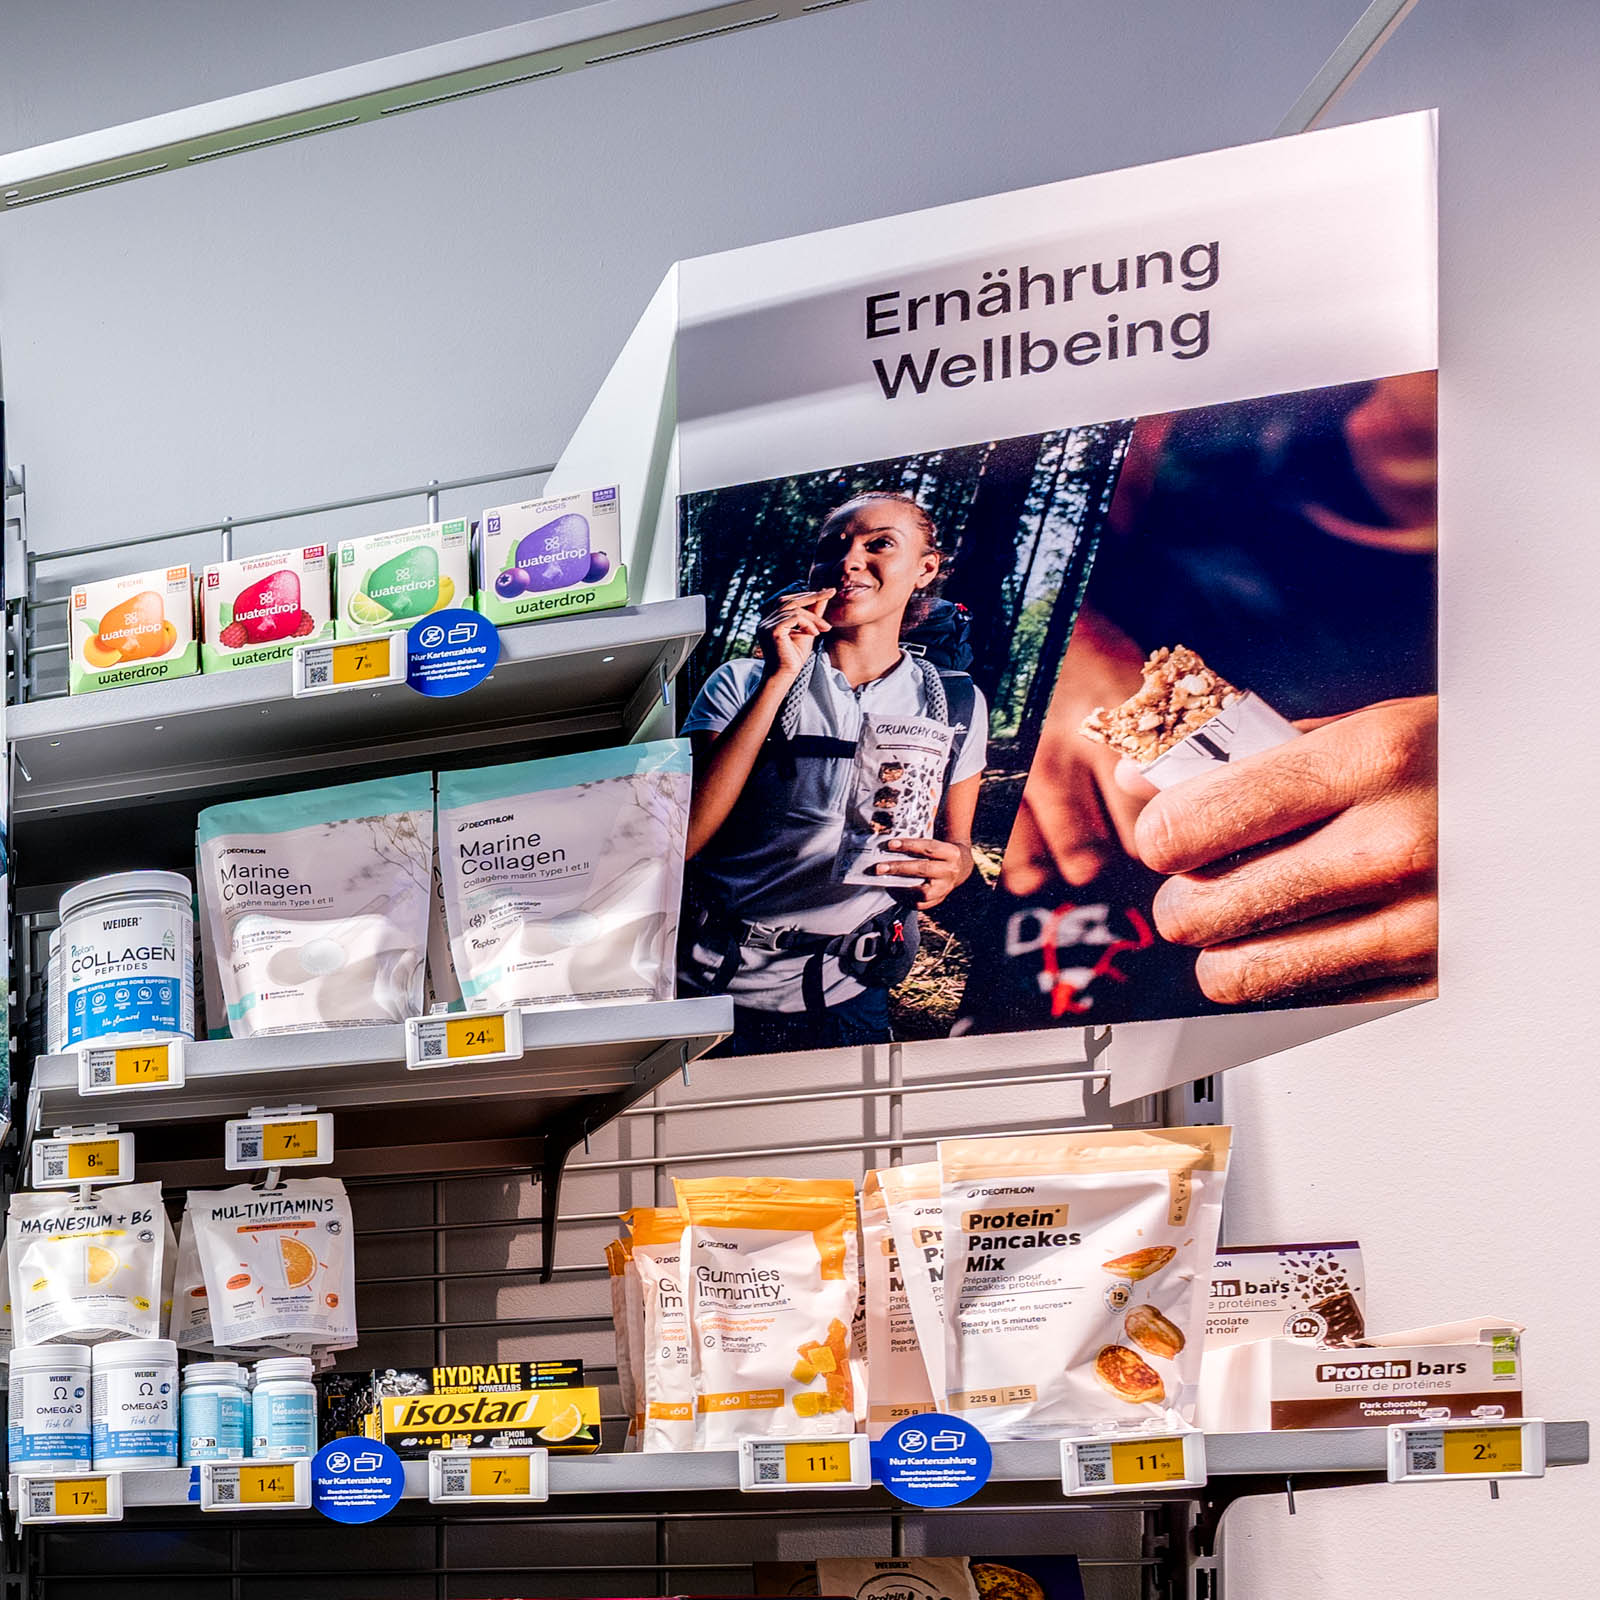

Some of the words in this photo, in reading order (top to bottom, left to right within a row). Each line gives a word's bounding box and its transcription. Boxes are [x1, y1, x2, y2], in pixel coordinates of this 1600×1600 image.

[865, 239, 1221, 339] Ernährung
[873, 309, 1212, 400] Wellbeing
[242, 557, 289, 572] FRAMBOISE
[518, 543, 588, 568] waterdrop
[370, 576, 436, 596] waterdrop
[235, 600, 299, 621] waterdrop
[101, 620, 161, 641] waterdrop
[469, 815, 514, 829] DECATHLON
[460, 833, 541, 858] Marine
[462, 849, 566, 875] Collagen
[221, 863, 289, 885] Marine
[463, 873, 509, 889] Collagène
[511, 871, 537, 880] marin
[540, 867, 562, 877] Type
[222, 879, 312, 902] Collagen
[102, 918, 139, 932] WEIDER
[71, 945, 176, 976] COLLAGEN
[95, 960, 149, 978] PEPTIDES
[982, 1186, 1035, 1196] DECATHLON
[211, 1196, 334, 1219] MULTIVITAMINS
[20, 1212, 110, 1233] MAGNESIUM
[112, 1214, 125, 1227] +
[128, 1208, 153, 1225] B6
[969, 1232, 1081, 1251] Pancakes
[966, 1255, 1005, 1272] Mix
[697, 1266, 780, 1284] Gummies
[964, 1275, 1015, 1284] Préparation
[1019, 1273, 1042, 1281] pour
[962, 1284, 1006, 1293] pancakes
[961, 1321, 989, 1329] Ready
[432, 1363, 522, 1387] HYDRATE
[1322, 1362, 1407, 1381] Protein
[1417, 1361, 1466, 1375] bars
[479, 1383, 522, 1392] POWERTABS
[1335, 1383, 1368, 1393] Barre
[1373, 1382, 1388, 1391] de
[1392, 1380, 1452, 1391] protéines
[970, 1395, 988, 1403] 225
[402, 1397, 529, 1427] isostar
[1364, 1409, 1405, 1417] Chocolat
[500, 1430, 525, 1438] LEMON
[908, 1457, 977, 1465] Kartenzahlung
